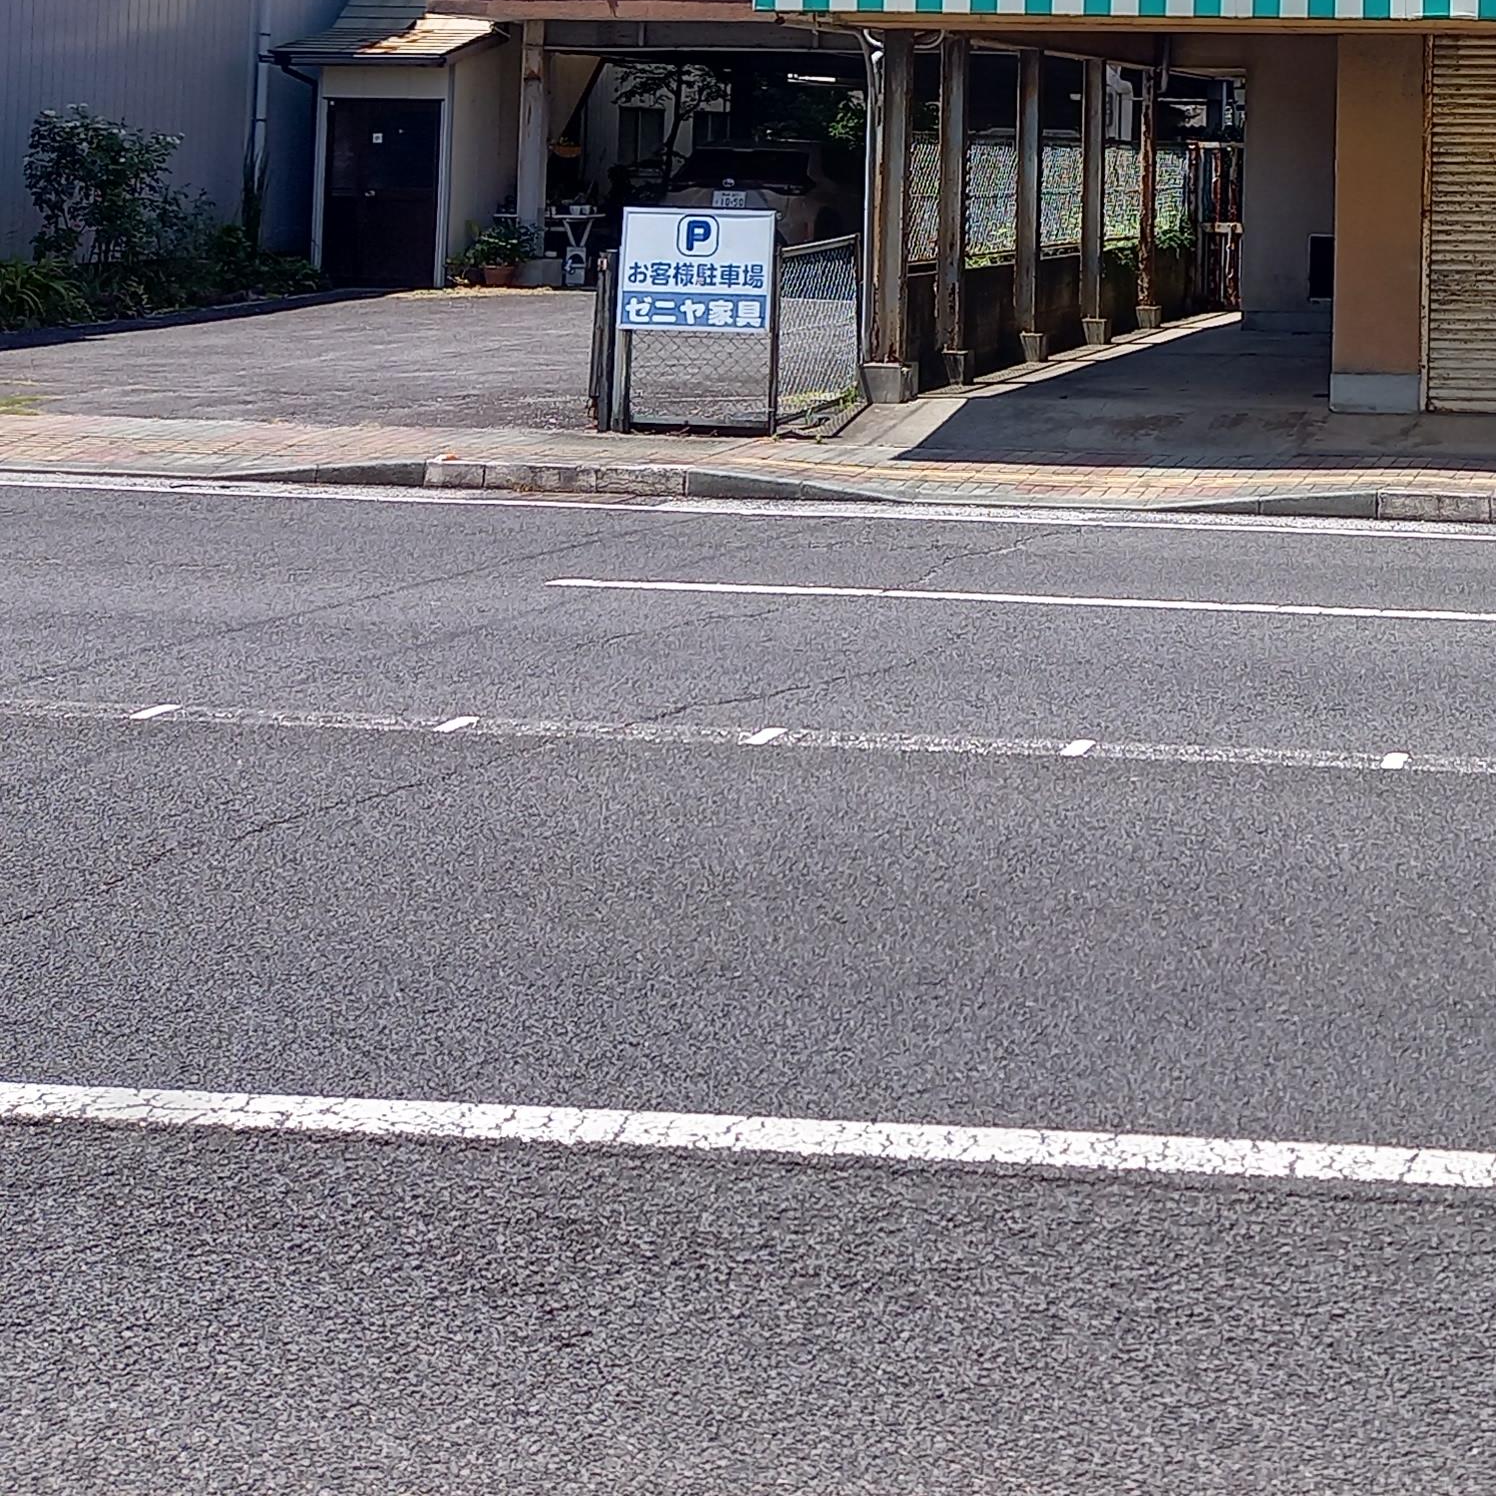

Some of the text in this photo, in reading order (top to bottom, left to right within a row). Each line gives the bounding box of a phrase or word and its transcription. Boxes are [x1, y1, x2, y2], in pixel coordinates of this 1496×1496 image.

[686, 220, 711, 251] P
[628, 262, 764, 288] お客様駐車場
[625, 297, 762, 327] ゼニヤ家具
